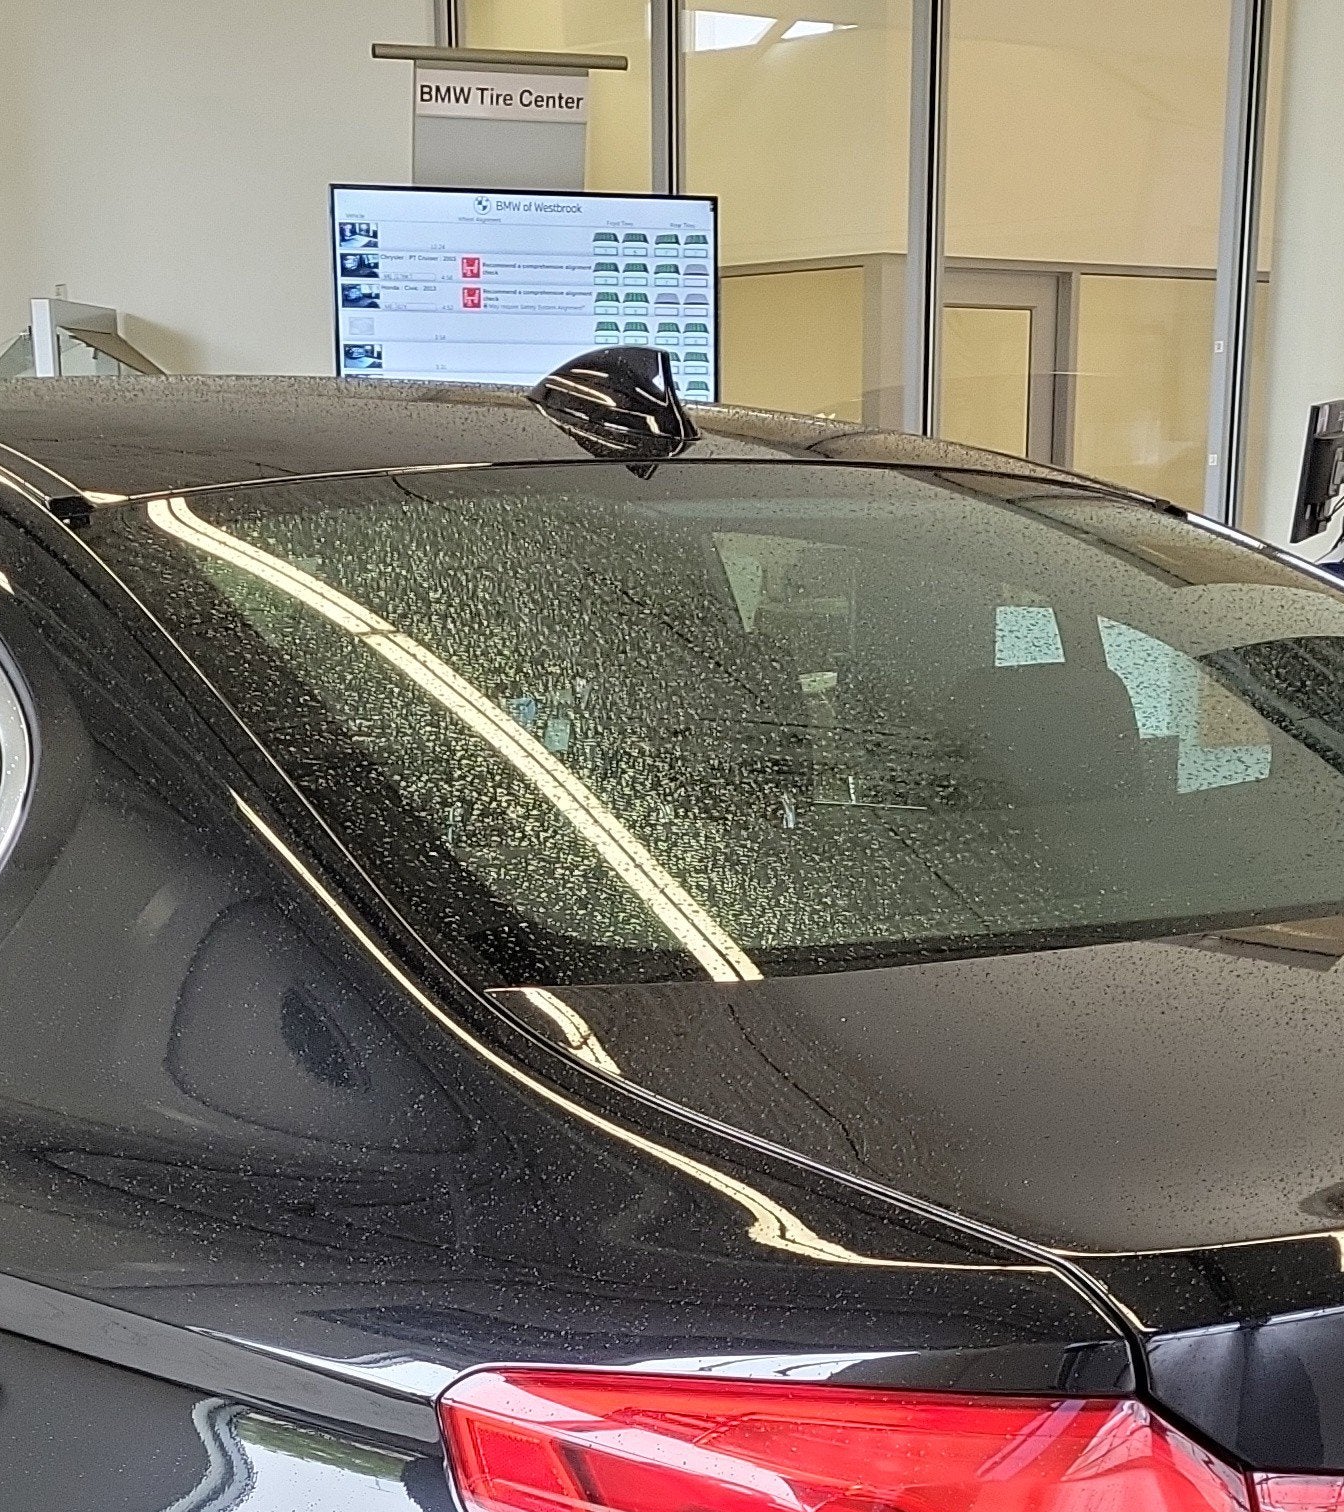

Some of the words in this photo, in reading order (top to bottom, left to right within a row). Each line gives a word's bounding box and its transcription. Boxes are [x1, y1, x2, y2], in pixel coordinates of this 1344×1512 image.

[419, 84, 472, 104] BMW
[476, 87, 513, 107] Tire
[519, 89, 584, 110] Center
[496, 201, 521, 212] BMW
[523, 201, 532, 212] of
[534, 202, 583, 214] Westbrook
